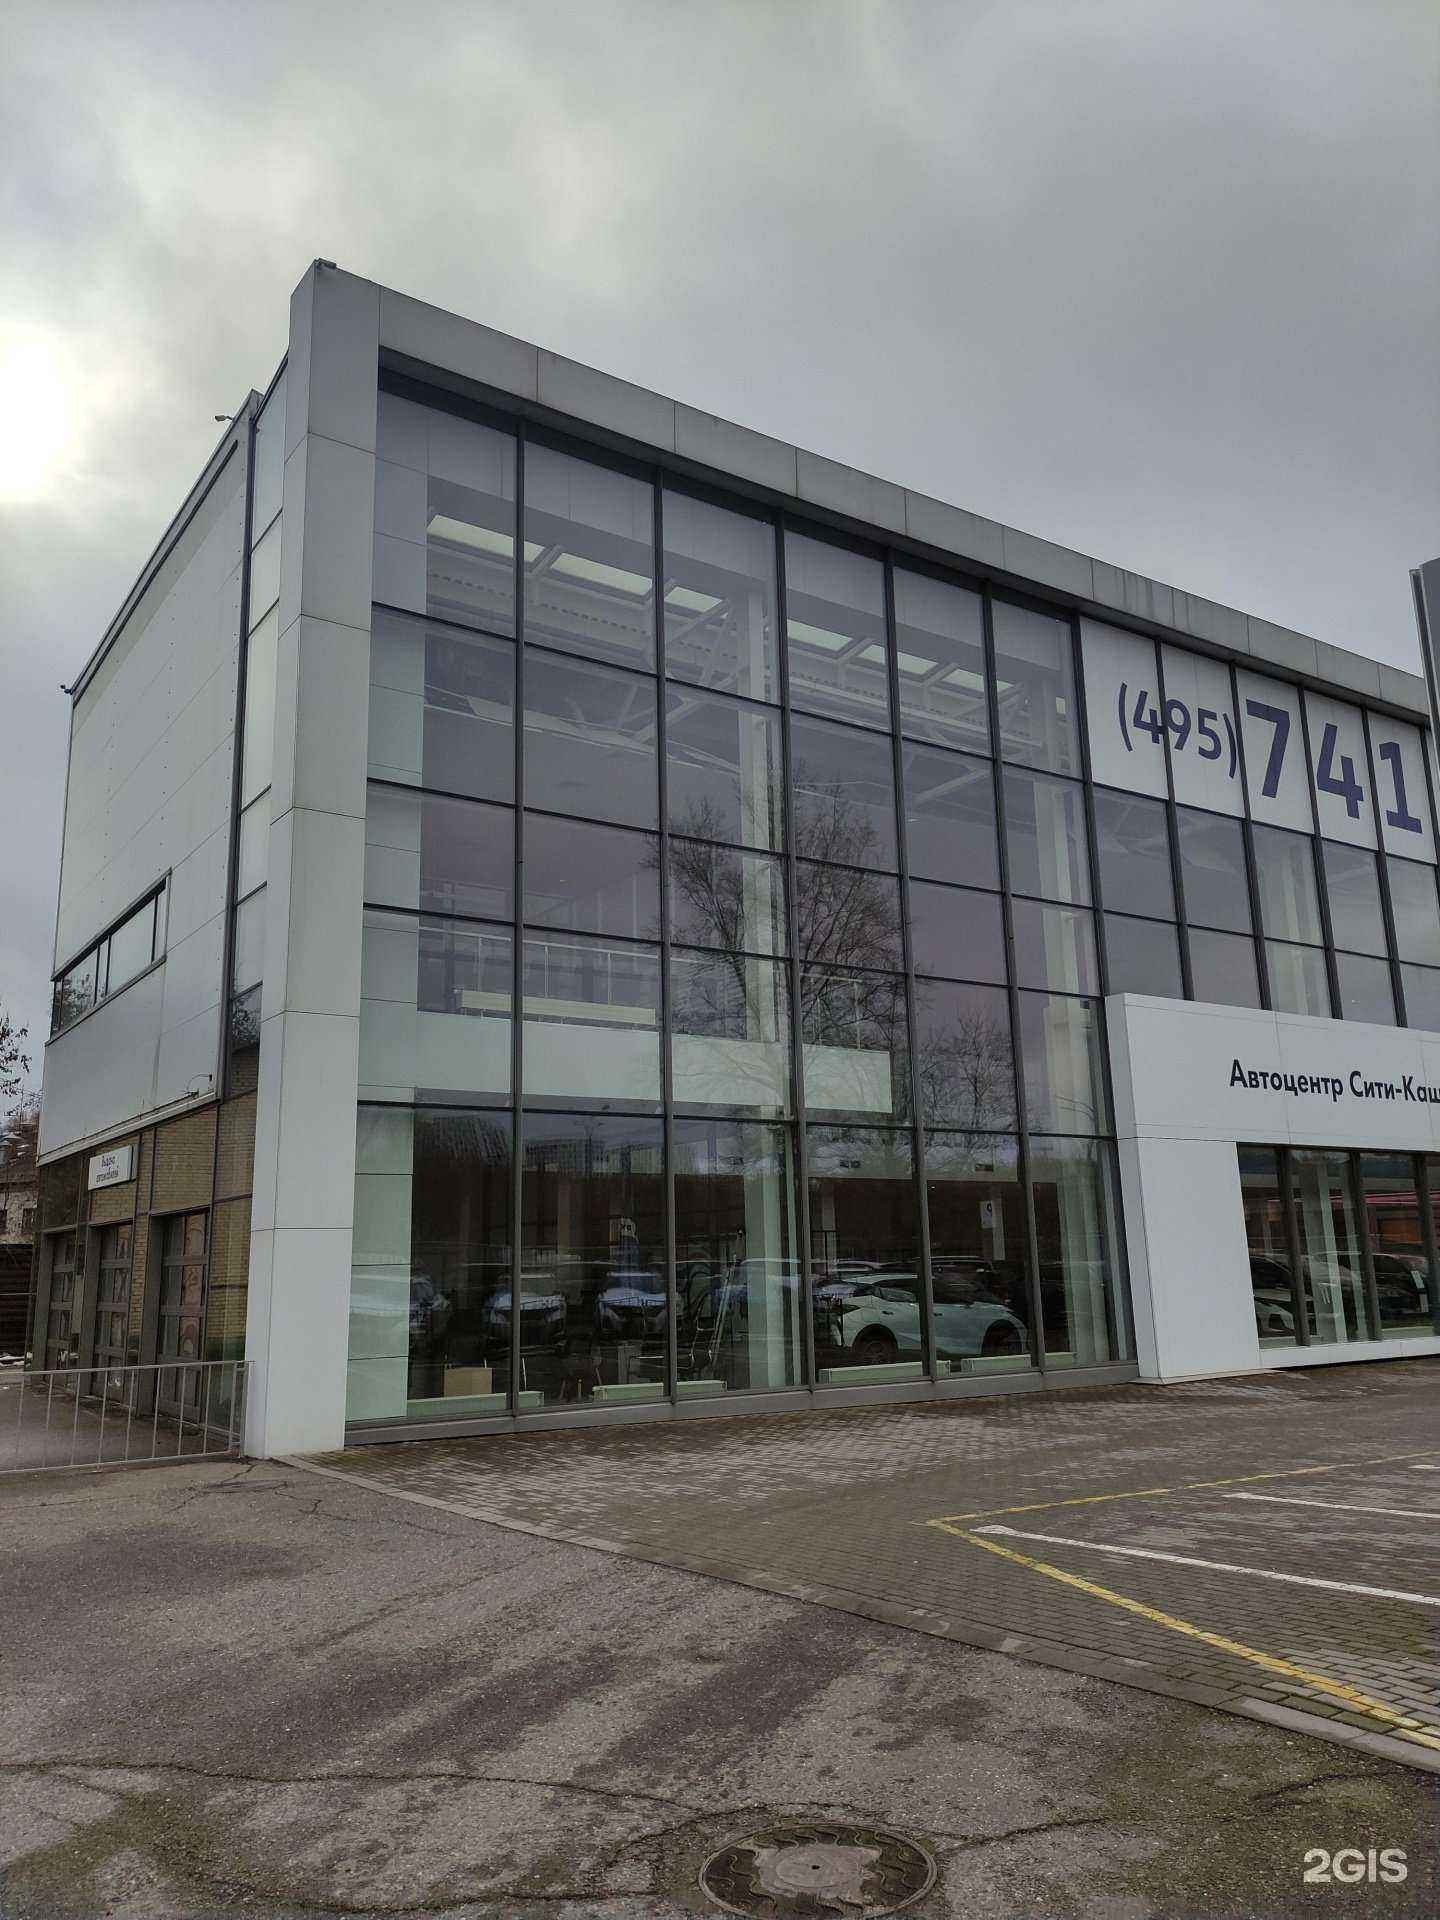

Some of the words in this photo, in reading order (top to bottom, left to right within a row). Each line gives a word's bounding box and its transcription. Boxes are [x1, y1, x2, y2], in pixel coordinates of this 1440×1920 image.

[1246, 697, 1423, 834] 741
[1230, 1058, 1344, 1102] Автоцентр
[1349, 1070, 1440, 1103] Сити-Каш
